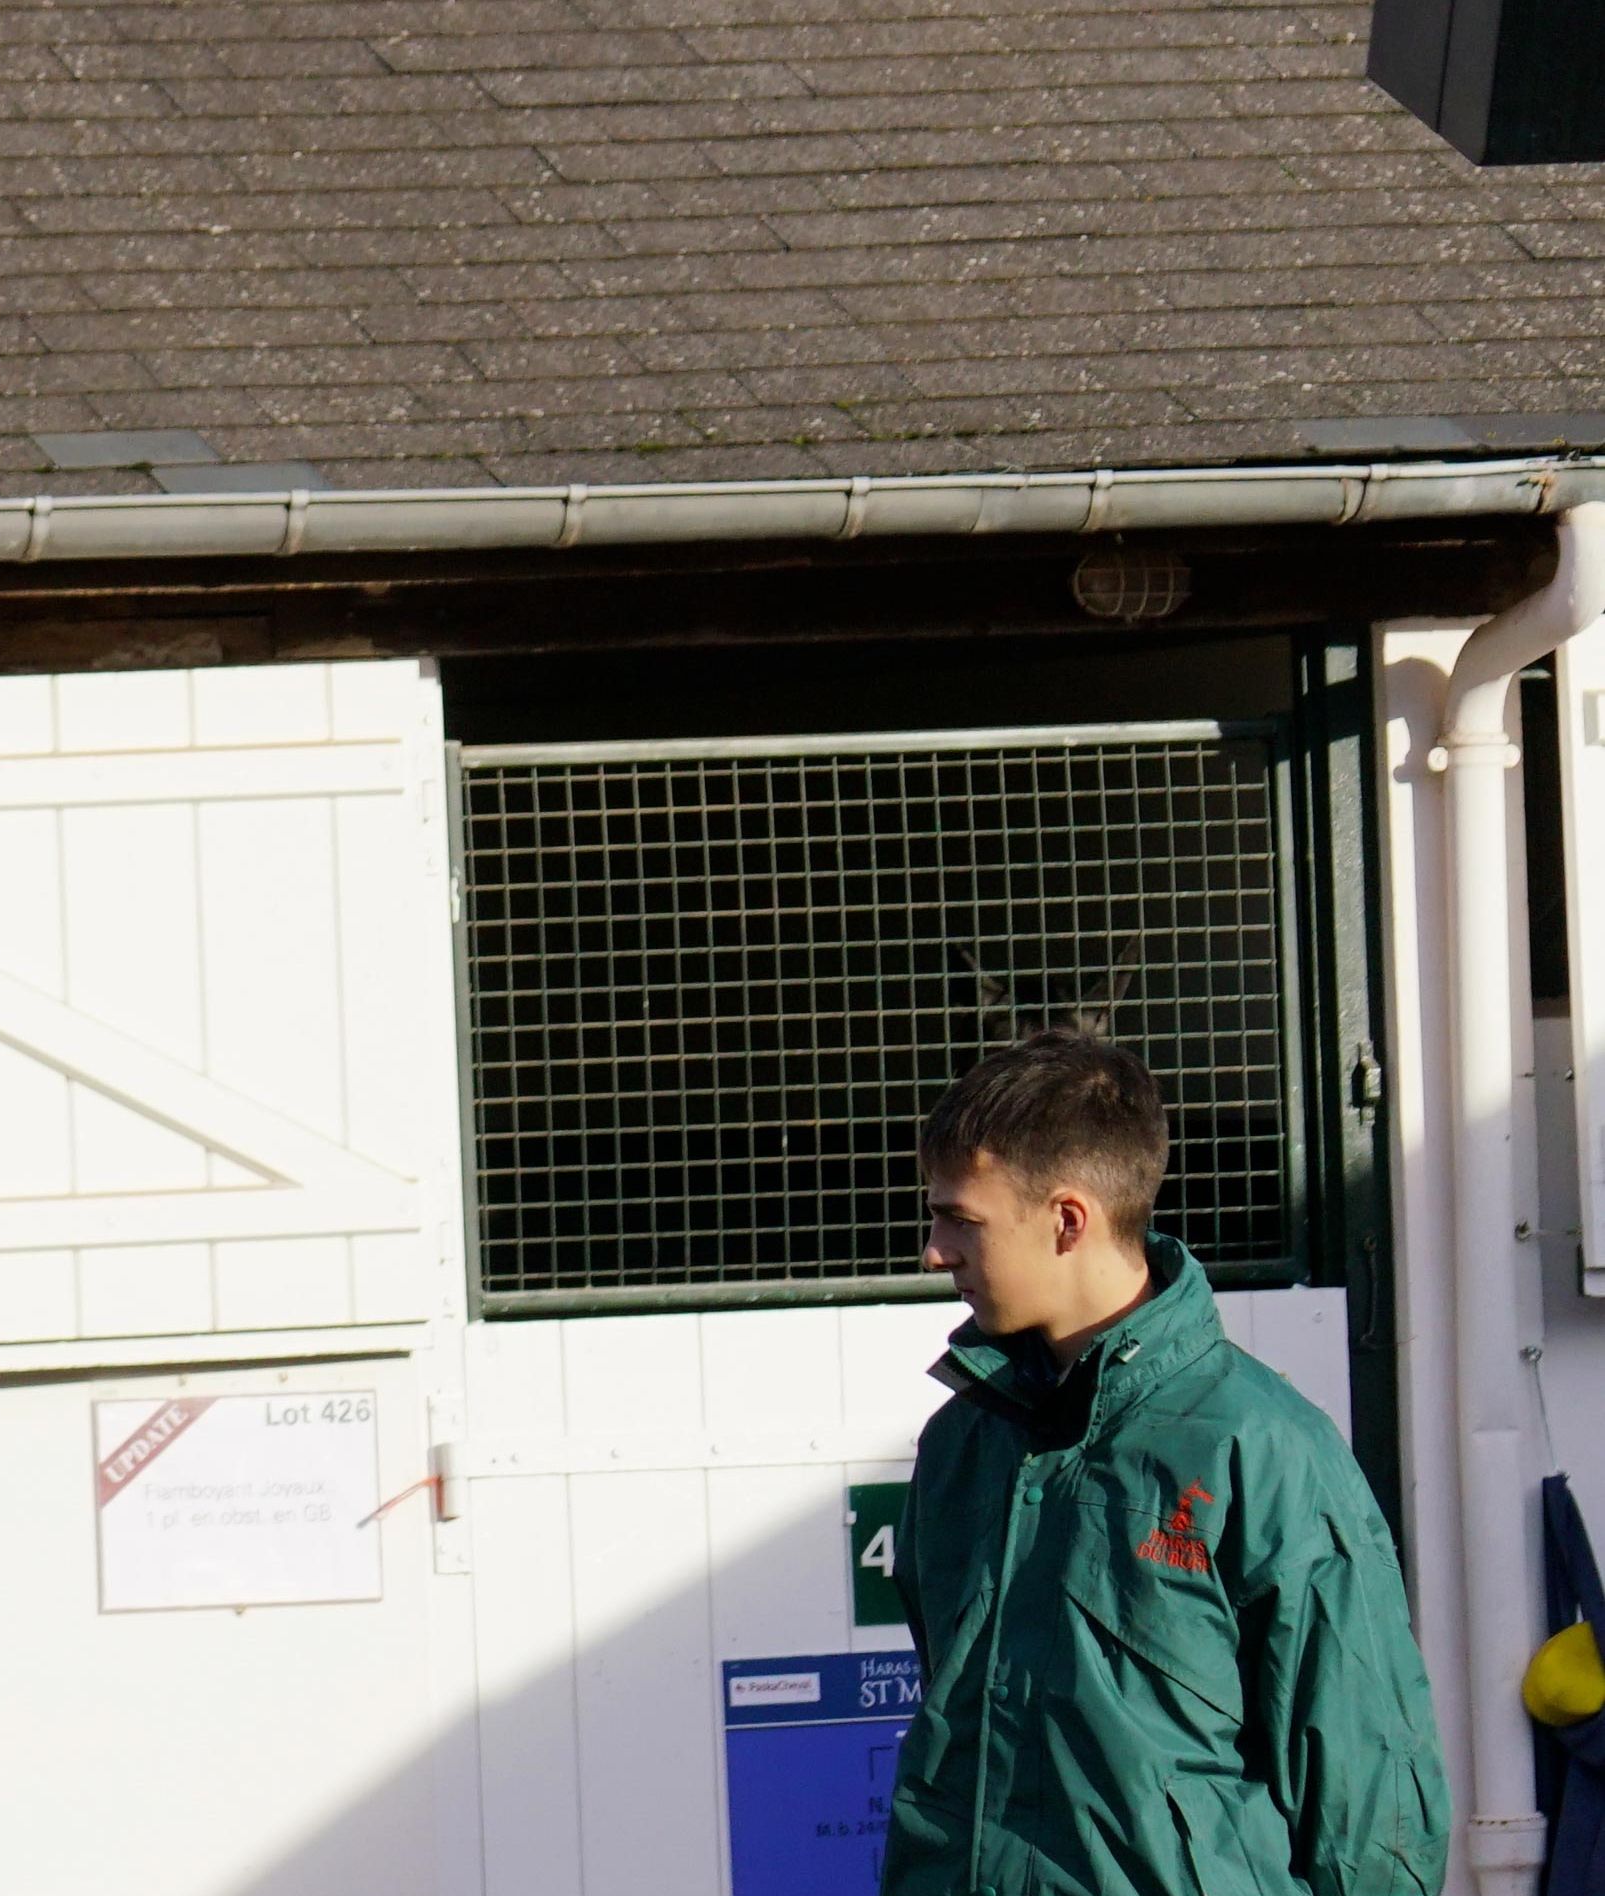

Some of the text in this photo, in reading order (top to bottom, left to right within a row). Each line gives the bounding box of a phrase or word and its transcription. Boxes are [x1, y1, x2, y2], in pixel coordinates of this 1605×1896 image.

[265, 1398, 373, 1426] Lot 426
[105, 1405, 188, 1483] UPDATE
[860, 1679, 893, 1708] ST
